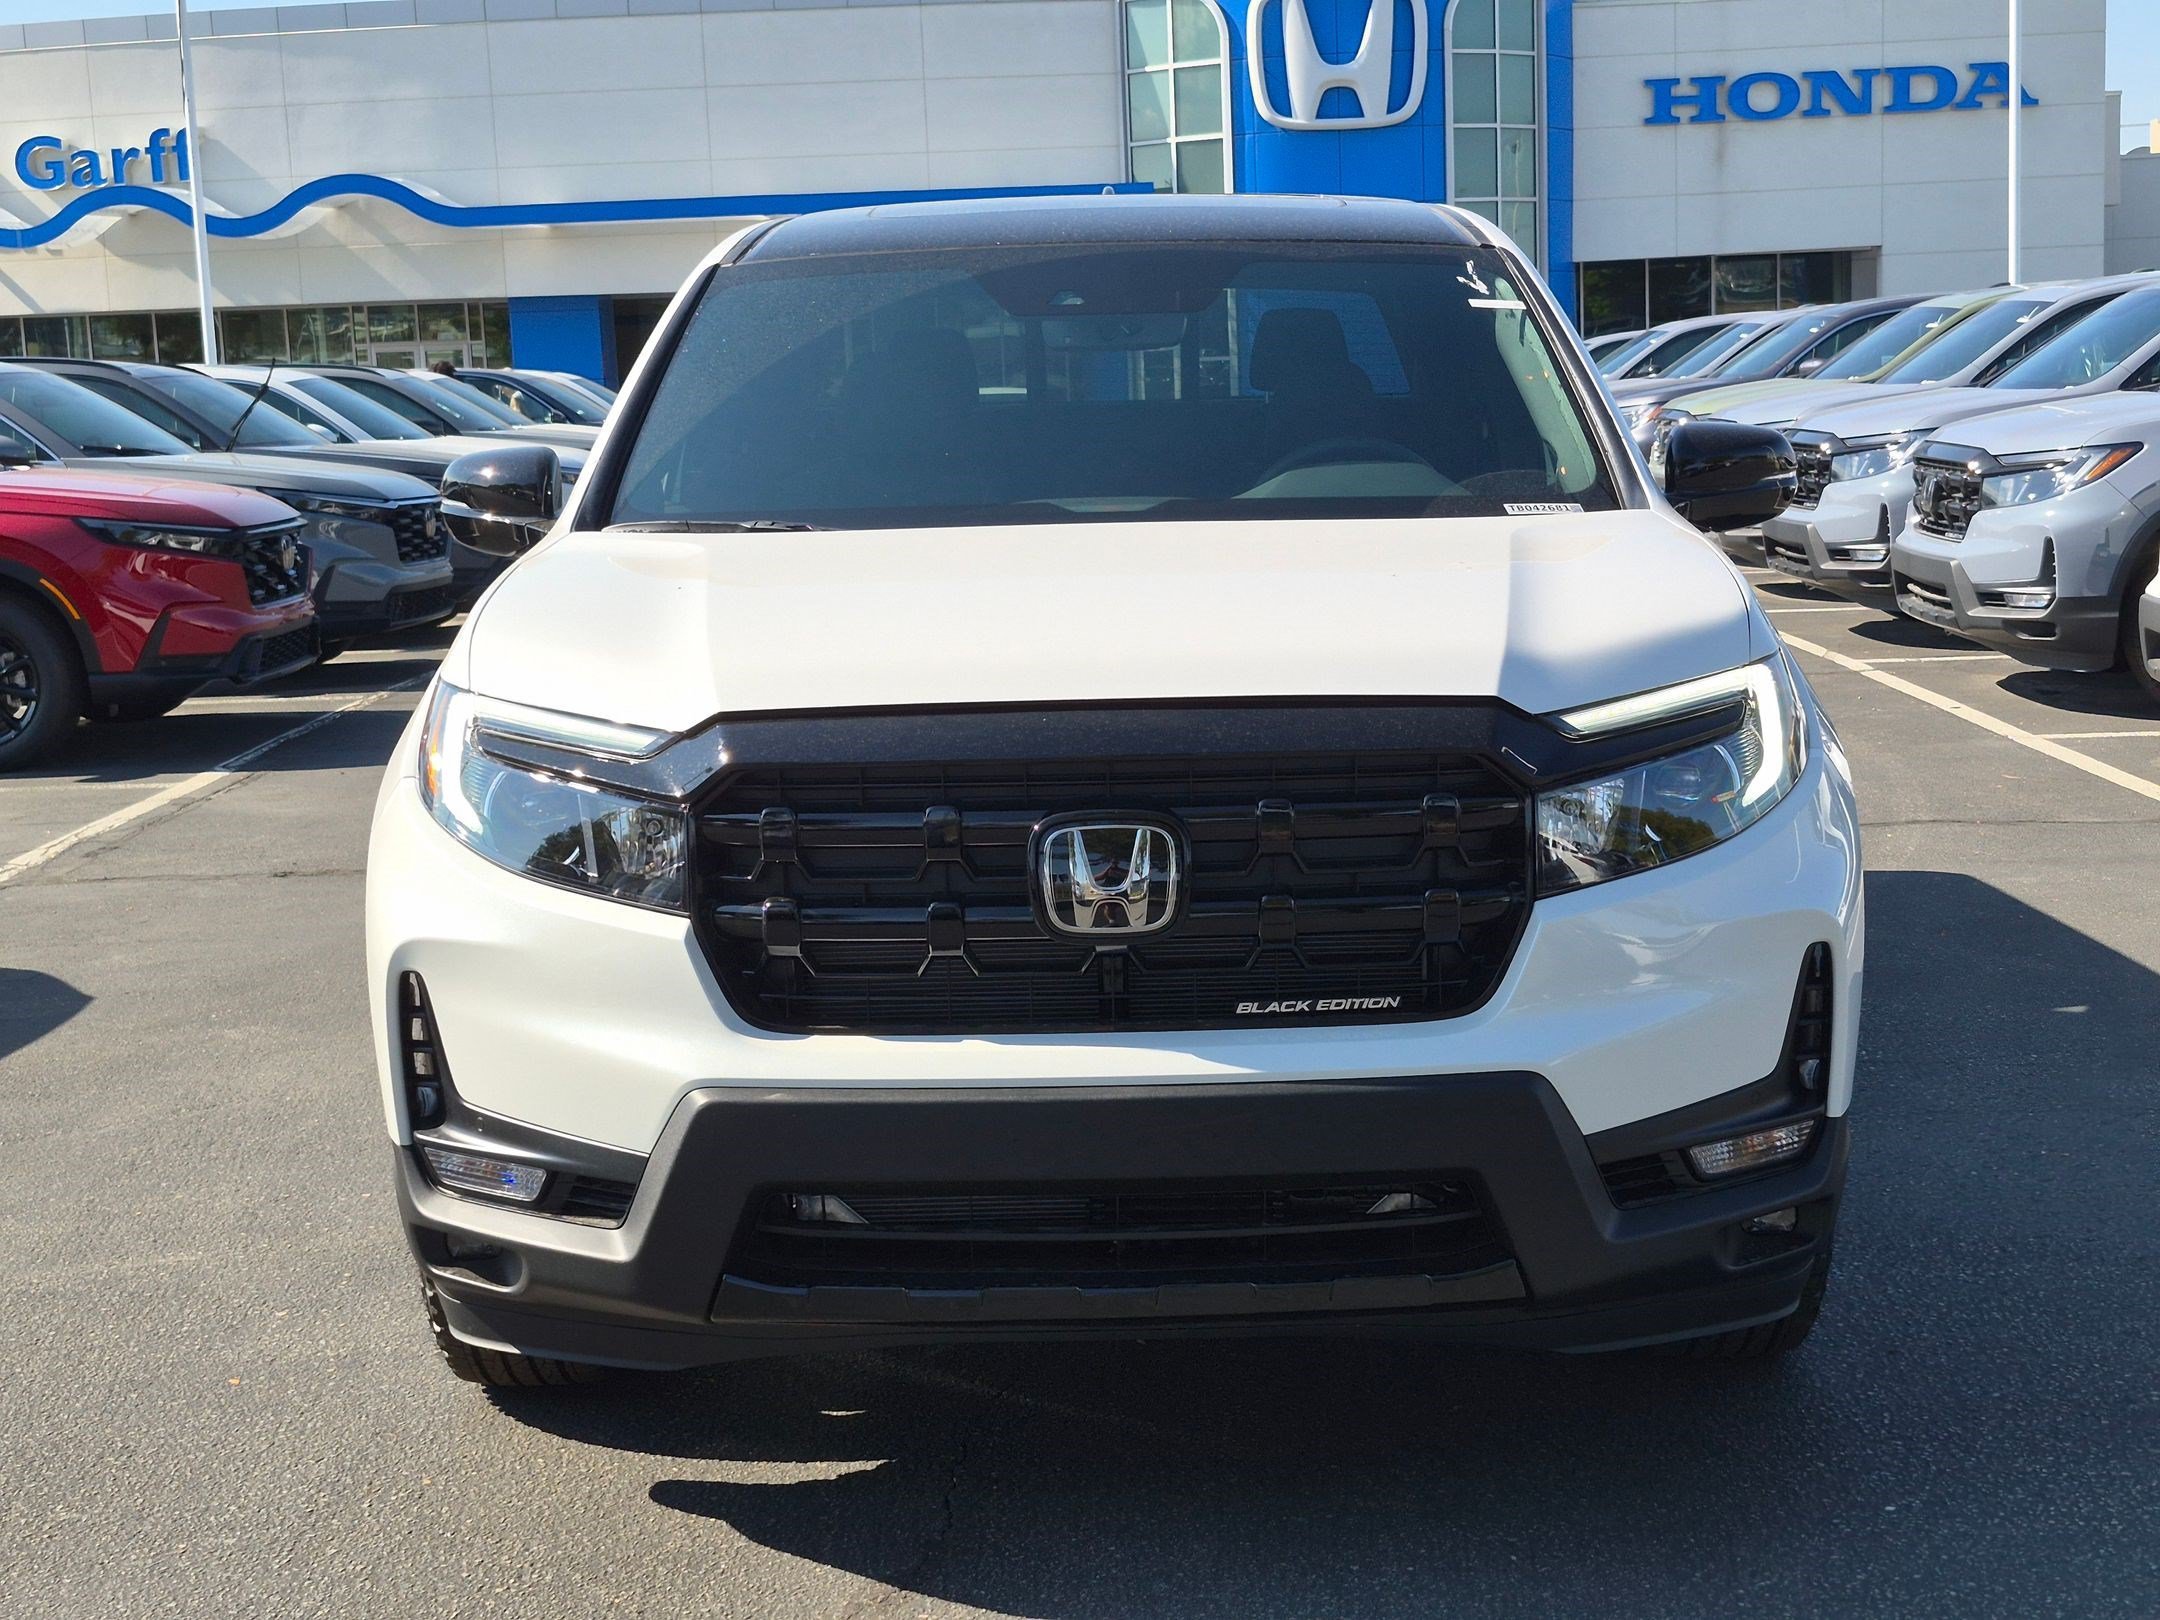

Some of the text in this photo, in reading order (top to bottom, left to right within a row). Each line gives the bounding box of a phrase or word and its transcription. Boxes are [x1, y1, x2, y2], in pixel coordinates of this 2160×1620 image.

[1643, 61, 2039, 125] HONDA
[1236, 996, 1401, 1014] BLACK EDITION
